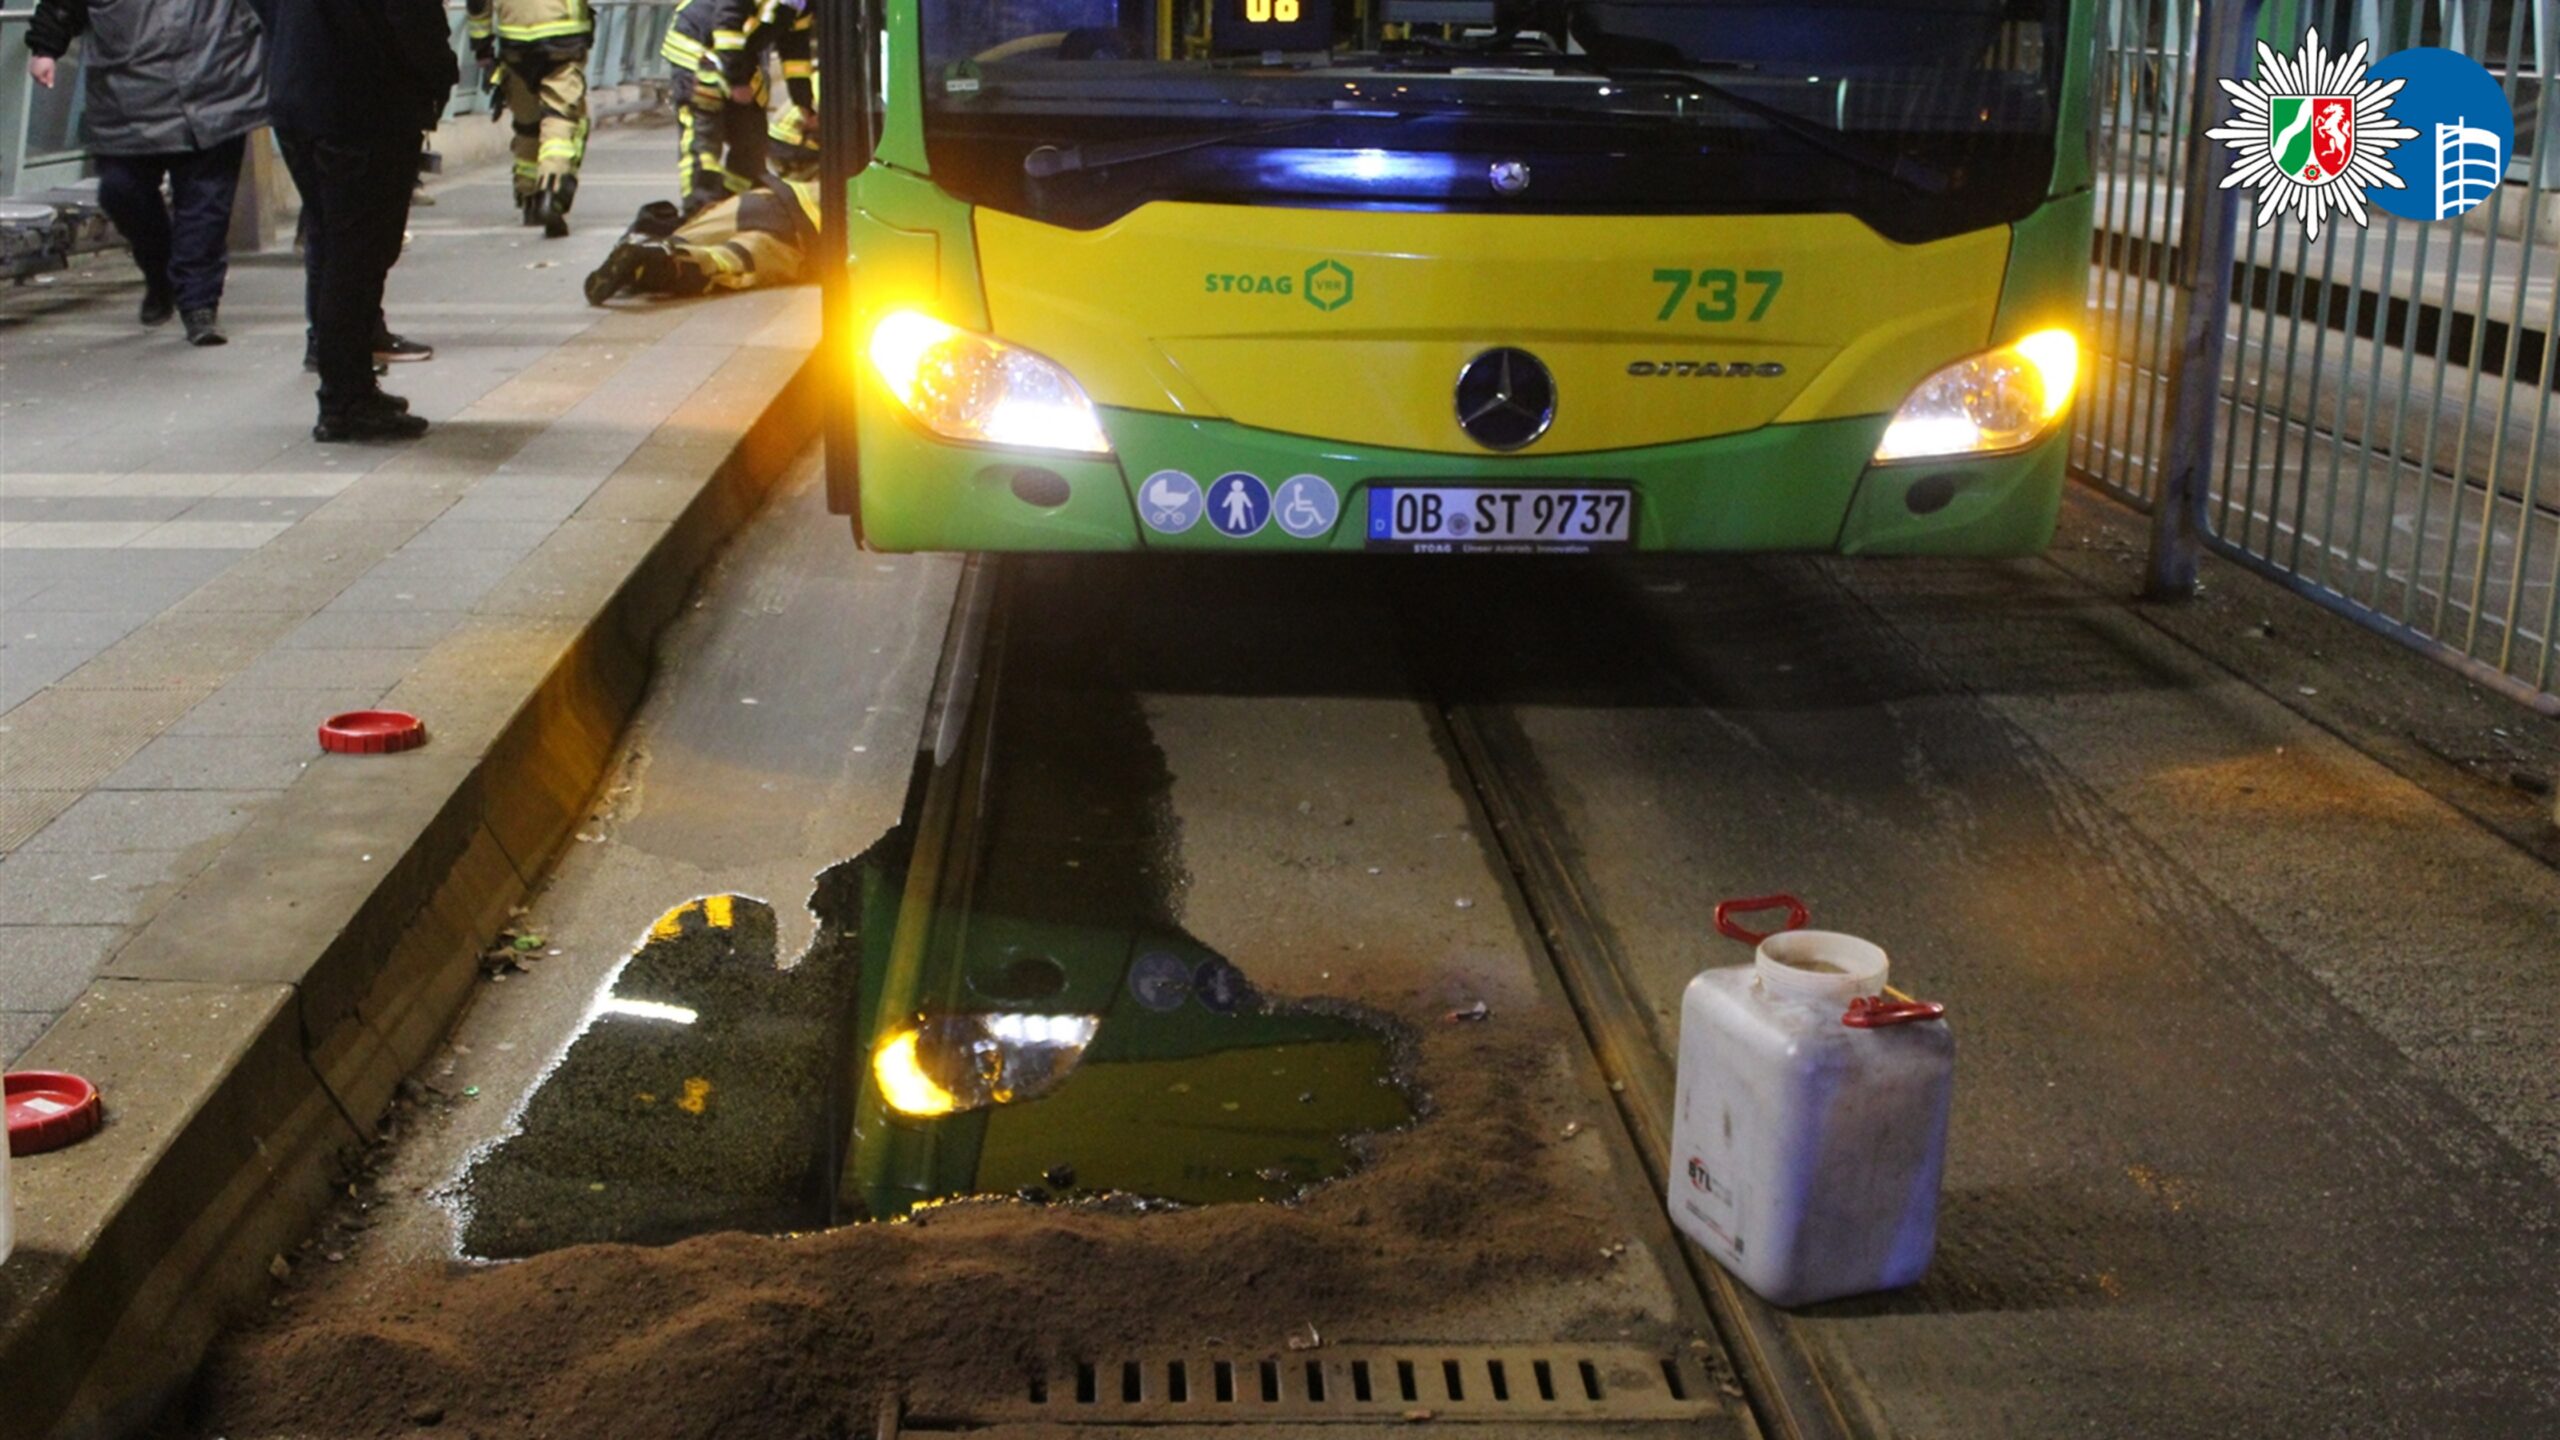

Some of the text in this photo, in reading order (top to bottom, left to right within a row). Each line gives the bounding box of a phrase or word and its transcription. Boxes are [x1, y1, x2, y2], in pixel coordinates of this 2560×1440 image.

[1205, 273, 1292, 294] STOAG
[1652, 268, 1783, 322] 737
[1396, 493, 1626, 534] OB ST 9737
[1413, 543, 1452, 554] STOAG
